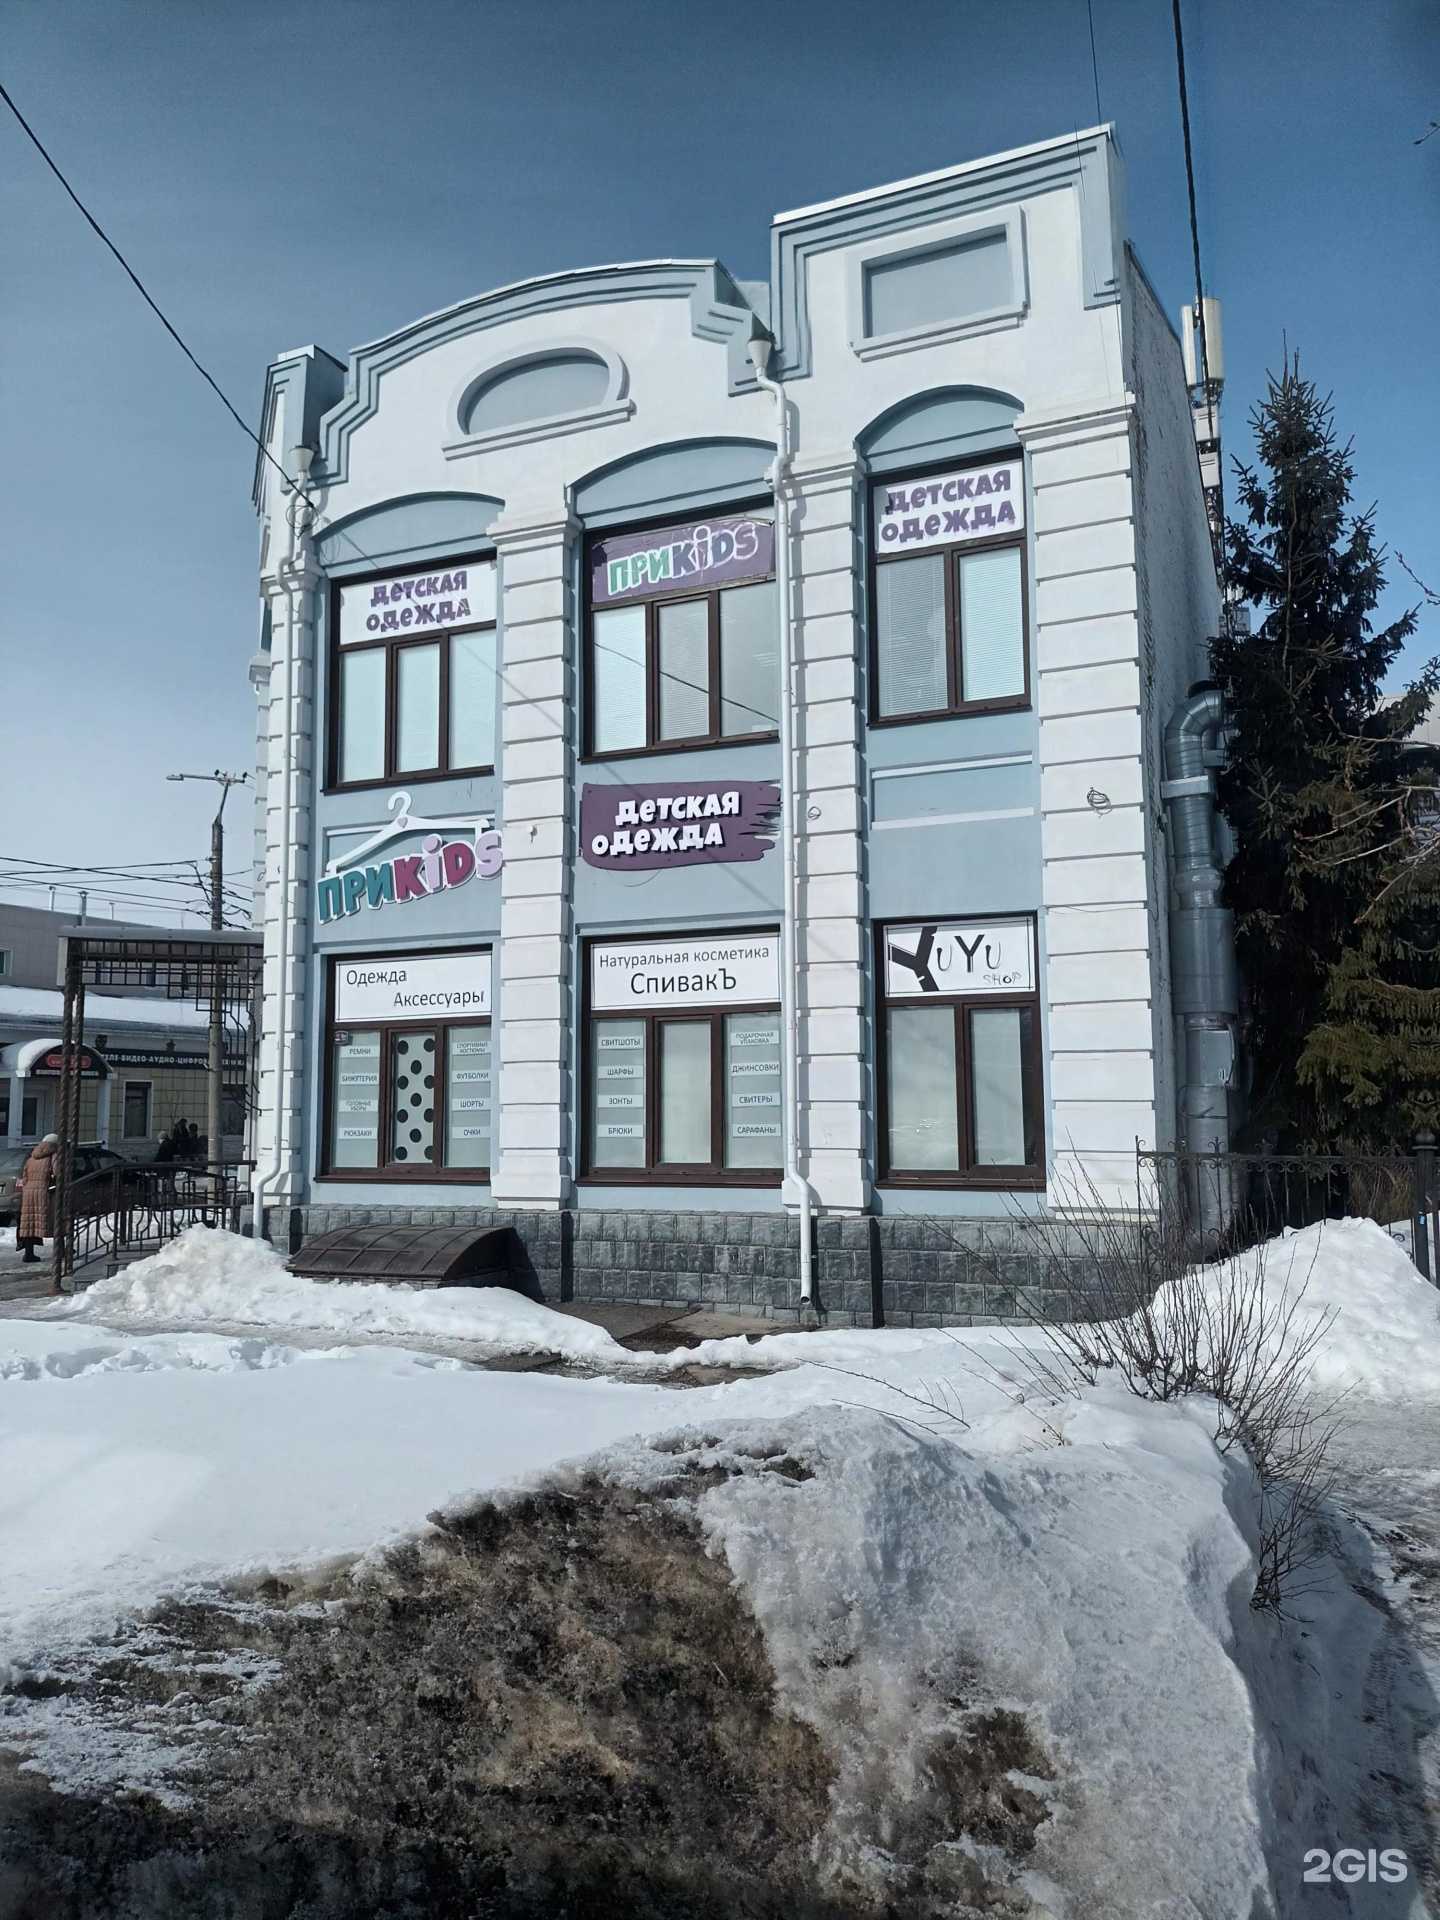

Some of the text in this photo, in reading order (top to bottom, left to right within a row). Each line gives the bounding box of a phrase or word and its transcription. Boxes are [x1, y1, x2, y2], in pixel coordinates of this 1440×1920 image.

[599, 947, 769, 969] Натуральная косметика
[346, 969, 408, 987] Одежда
[630, 968, 737, 995] СпивакЪ
[393, 990, 485, 1009] Аксессуары
[601, 1037, 641, 1046] СВИТШОТЫ
[607, 1067, 634, 1076] ШАРФЫ
[732, 1063, 779, 1073] ДЖИНСОВКИ
[456, 1072, 489, 1081] ФУТБОЛКИ
[460, 1099, 485, 1109] ШОРТЫ
[608, 1097, 633, 1105] ЗОНТЫ
[739, 1095, 773, 1104] СВИТЕРЫ
[608, 1127, 633, 1136] БРЮКИ
[737, 1125, 777, 1134] САРАФАНЫ
